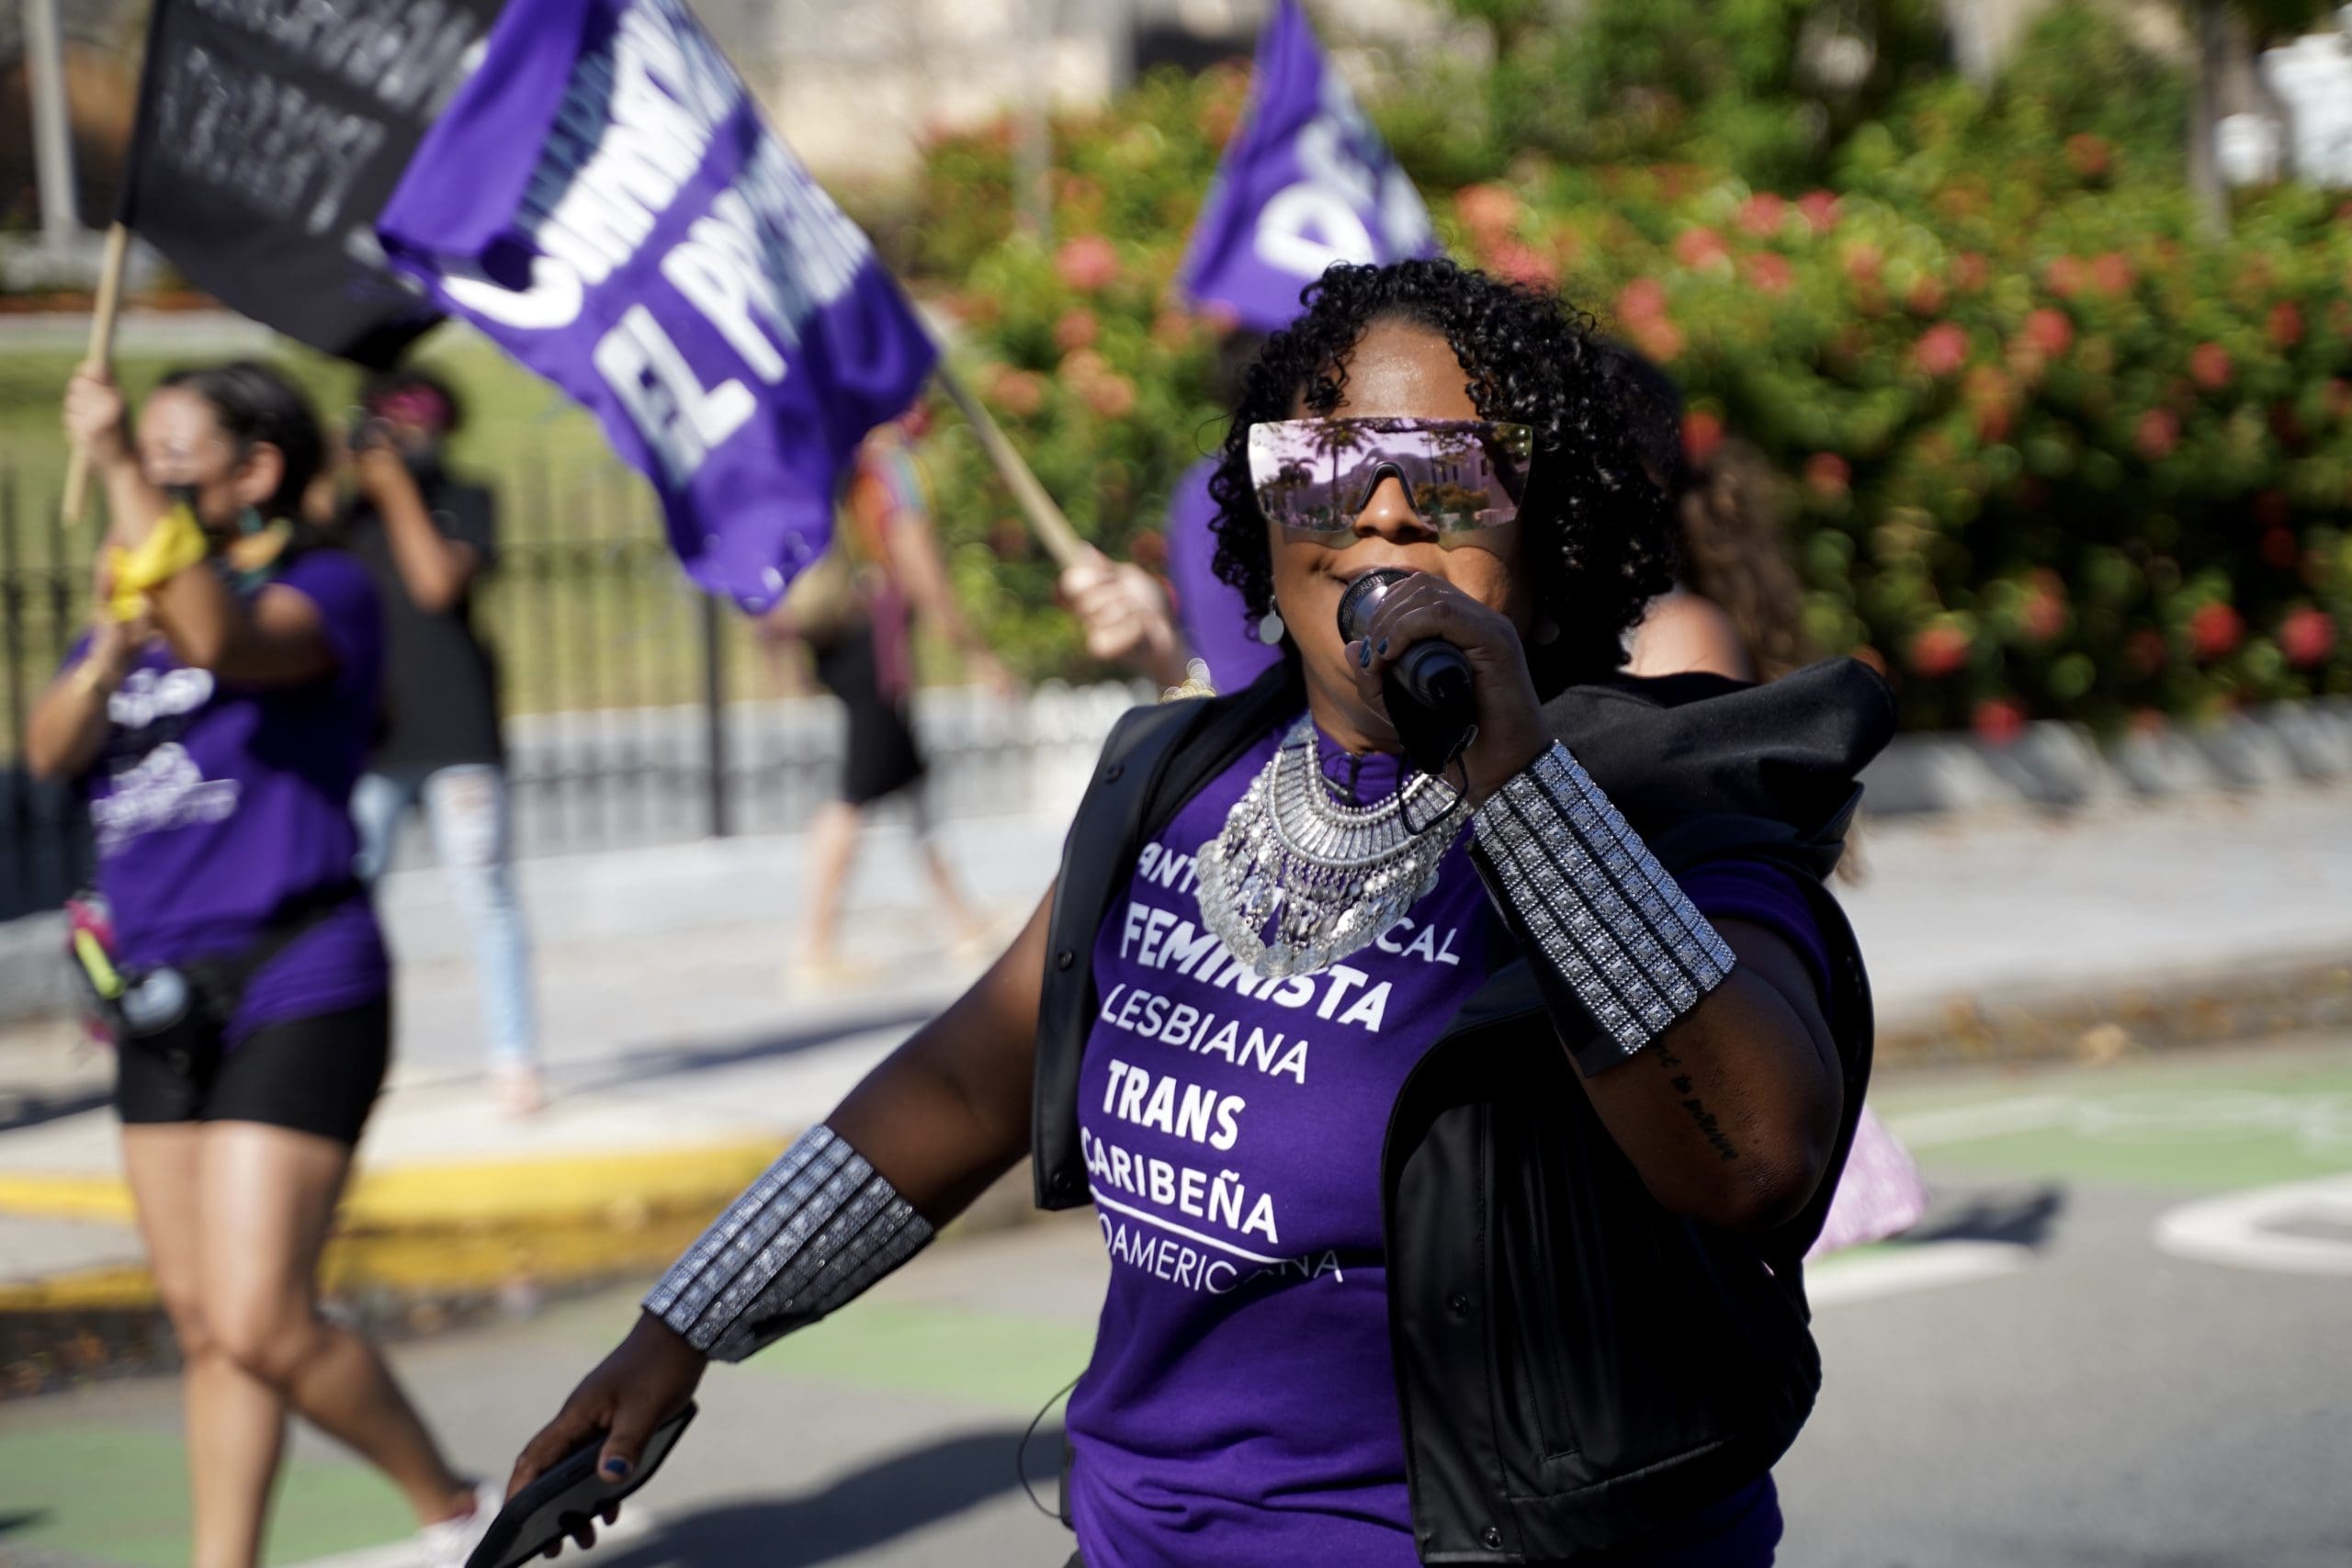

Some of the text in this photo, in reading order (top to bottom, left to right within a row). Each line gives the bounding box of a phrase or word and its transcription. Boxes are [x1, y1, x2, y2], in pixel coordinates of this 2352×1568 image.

[1120, 902, 1393, 1032] FEMINISTA
[1101, 983, 1308, 1084] LESBIANA
[1102, 1058, 1246, 1150] TRANS
[1080, 1126, 1279, 1244] CARIBEÑA
